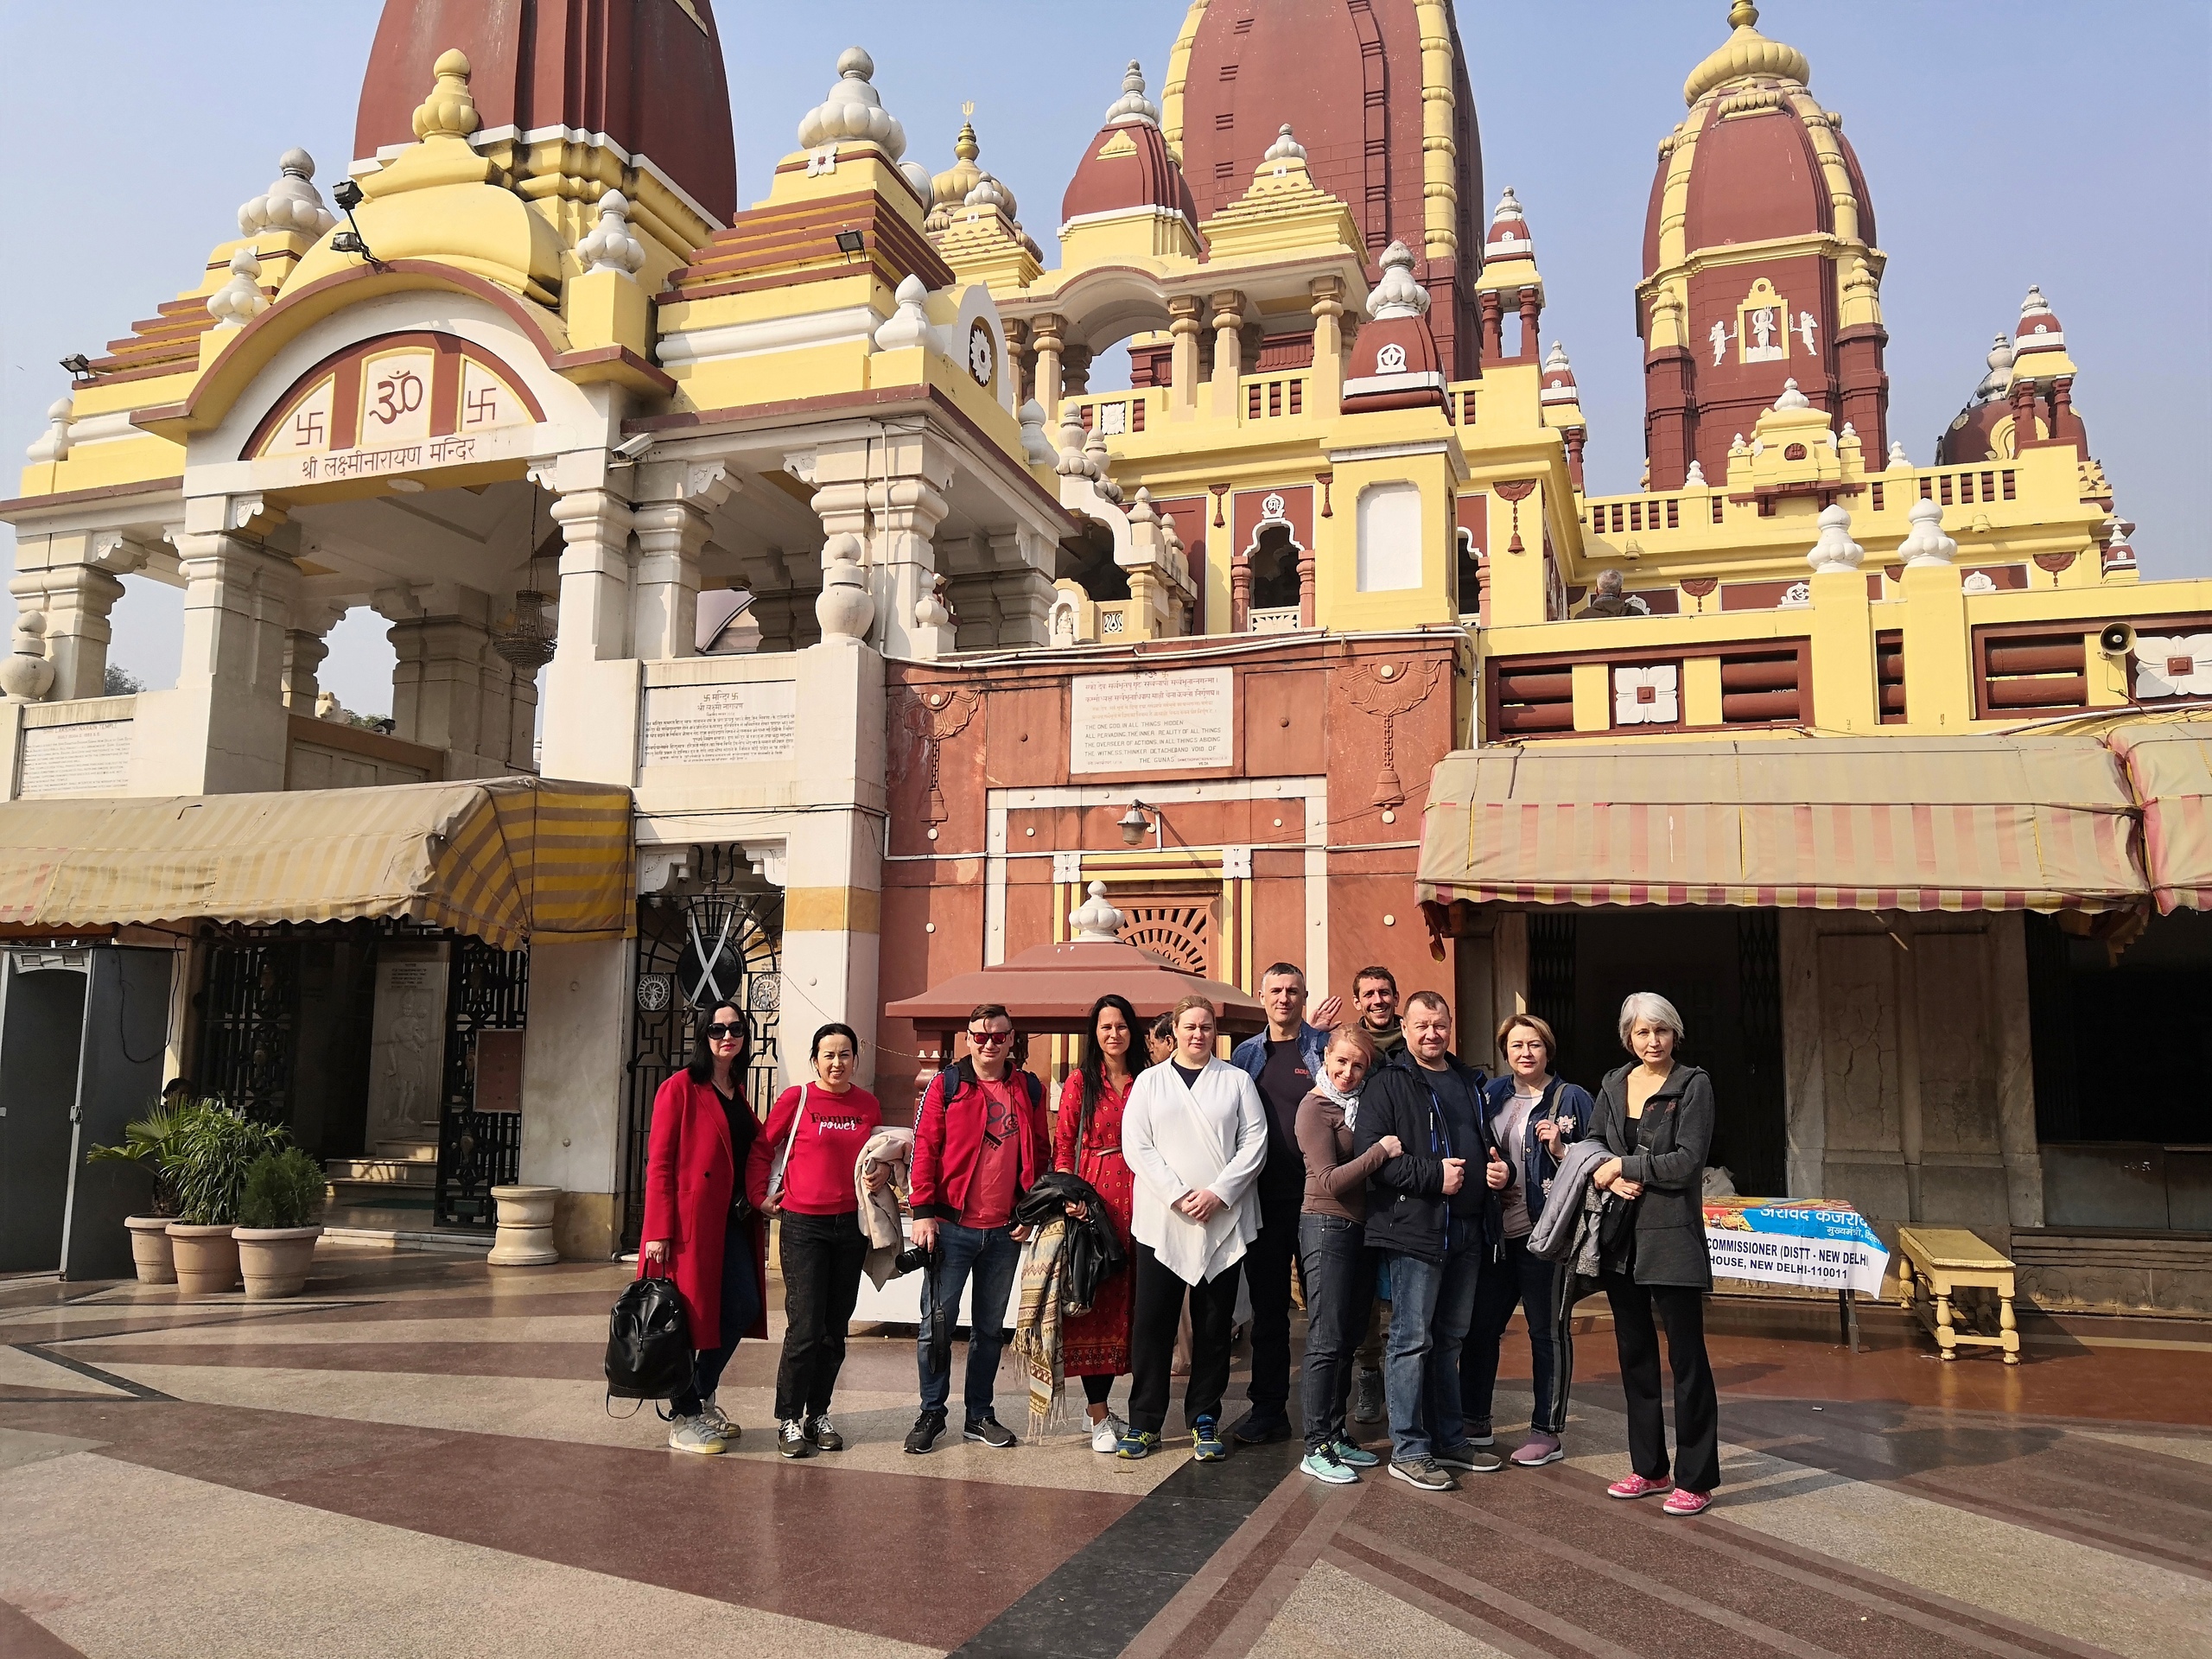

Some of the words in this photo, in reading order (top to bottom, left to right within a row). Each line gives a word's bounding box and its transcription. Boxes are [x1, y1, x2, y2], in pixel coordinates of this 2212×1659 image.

[302, 455, 318, 479] श्री
[324, 446, 422, 477] लक्ष्मीनारायण
[429, 437, 475, 462] मन्दिर
[810, 1112, 862, 1124] Femme
[818, 1120, 857, 1135] power
[1707, 1238, 1777, 1257] COMMISSIONER
[1781, 1245, 1810, 1261] (DISTT
[1819, 1249, 1840, 1263] NEW
[1750, 1260, 1773, 1271] NEW
[1777, 1262, 1847, 1279] DELHI-110011
